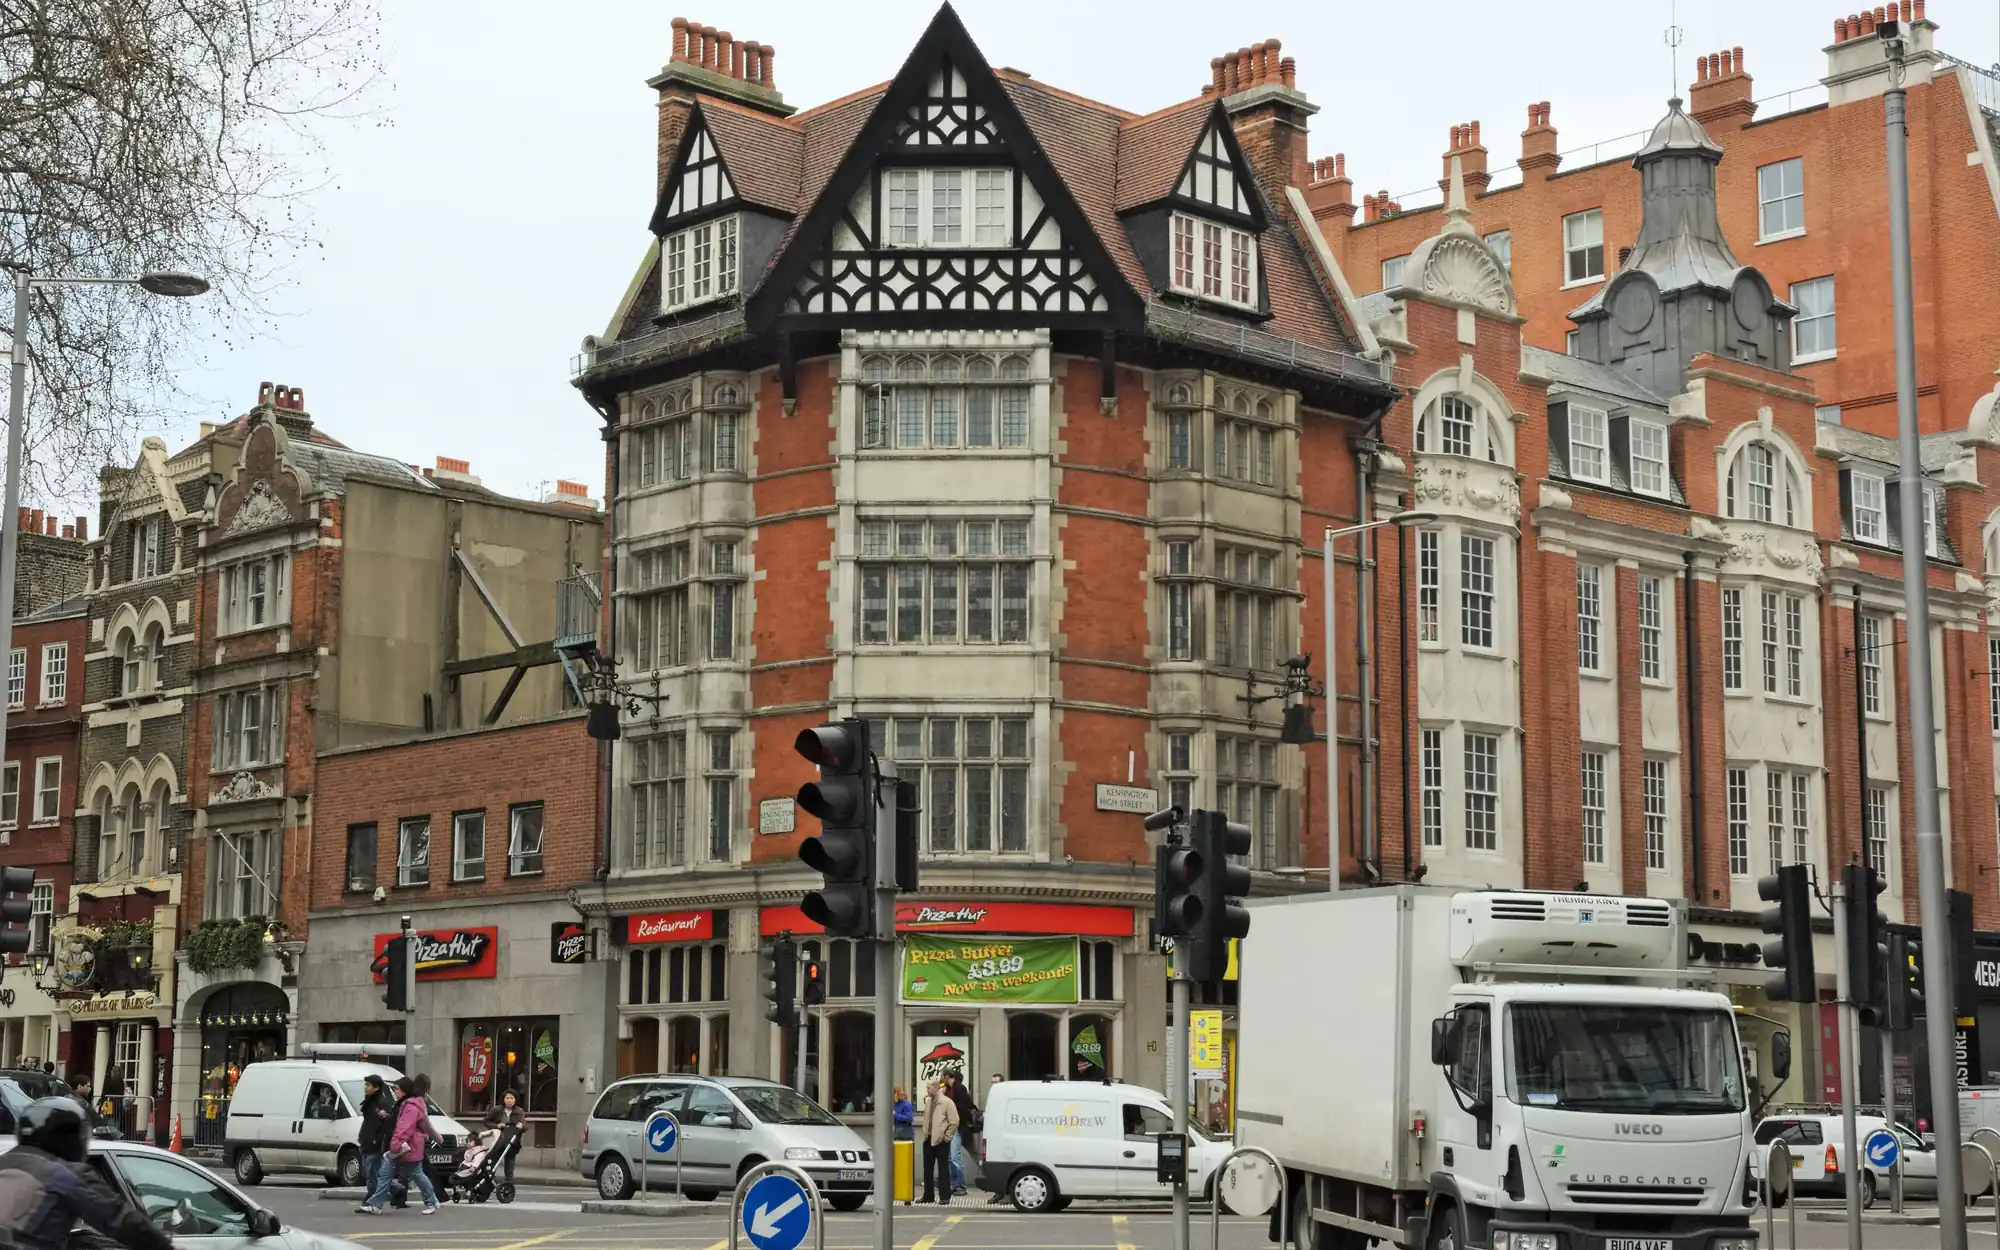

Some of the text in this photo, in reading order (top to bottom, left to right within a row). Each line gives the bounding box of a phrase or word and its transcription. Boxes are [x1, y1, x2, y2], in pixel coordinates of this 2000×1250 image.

[1106, 789, 1148, 799] KENSINGTON
[1100, 798, 1117, 806] HIGH
[1120, 800, 1143, 809] STREET
[1552, 896, 1620, 905] THERMO KING
[917, 907, 987, 922] Pizza Hut
[637, 913, 702, 938] Restaurant
[414, 933, 483, 961] Pizza Hut
[558, 935, 585, 956] Pizza
[563, 944, 583, 959] Hut
[910, 944, 1014, 964] Pizza Buffet
[967, 956, 1024, 980] £3.99
[944, 980, 977, 996] Now
[981, 980, 999, 992] at
[1003, 964, 1073, 988] weekends
[109, 999, 119, 1011] OF
[469, 1047, 487, 1075] 1/2
[469, 1075, 485, 1087] price
[1011, 1113, 1068, 1127] BASCOMB
[1070, 1114, 1107, 1127] DREW
[1614, 1123, 1663, 1135] IVECO
[1570, 1174, 1708, 1185] EUROCARGO
